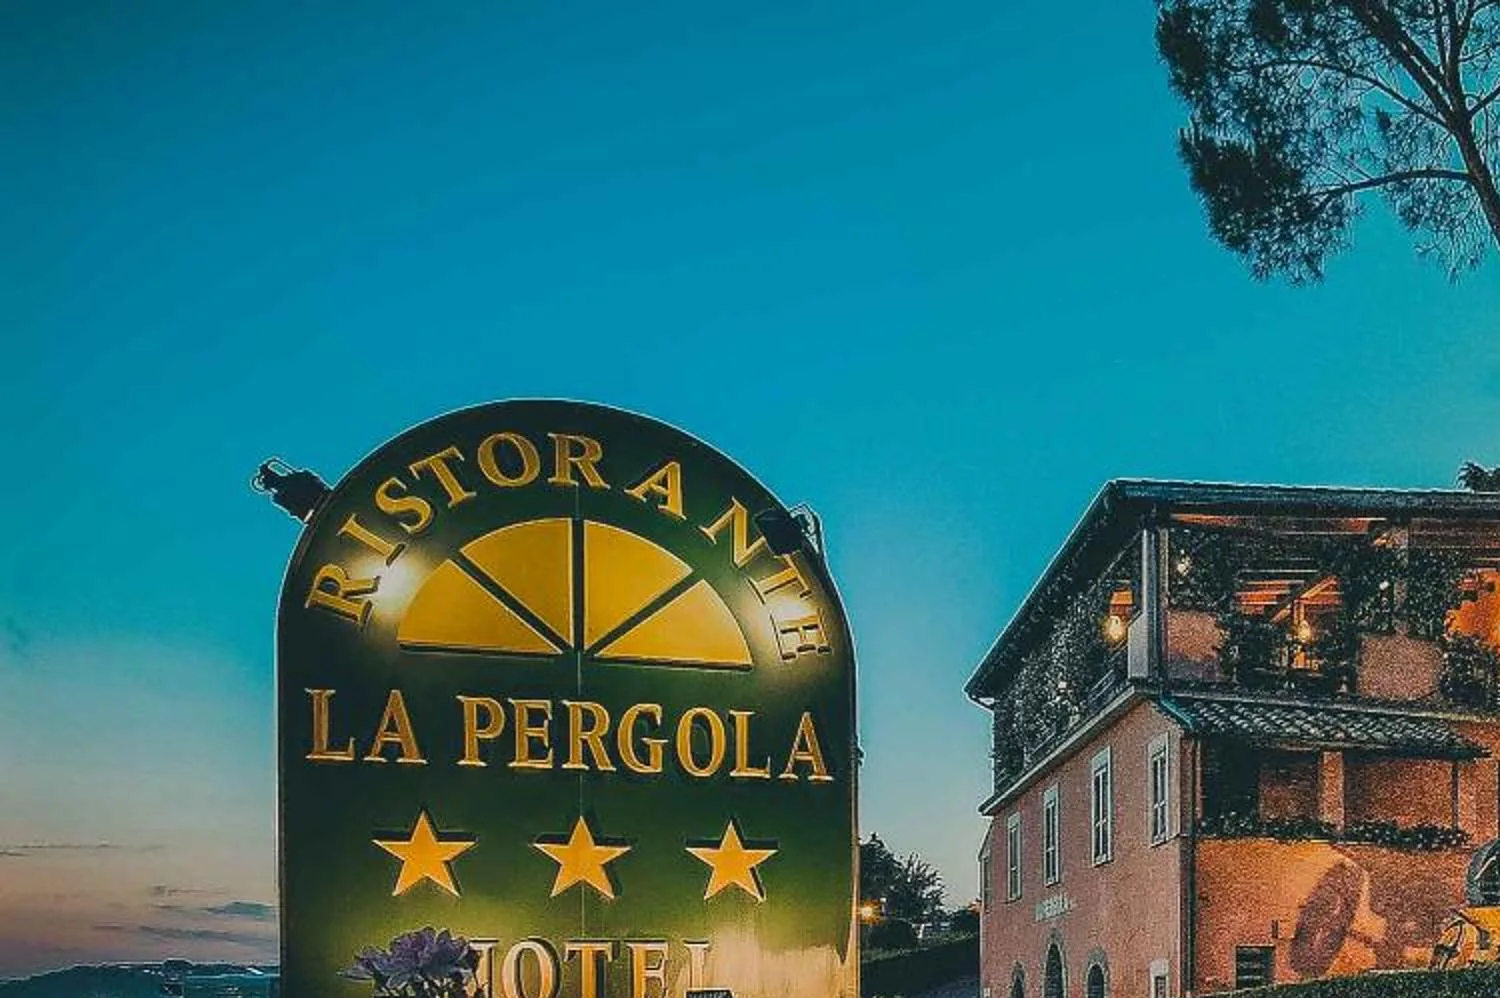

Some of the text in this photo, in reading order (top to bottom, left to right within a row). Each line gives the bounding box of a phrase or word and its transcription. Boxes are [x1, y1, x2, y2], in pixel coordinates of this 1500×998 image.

[305, 431, 833, 662] RISTORANTE
[304, 687, 834, 782] LA PERGOLA
